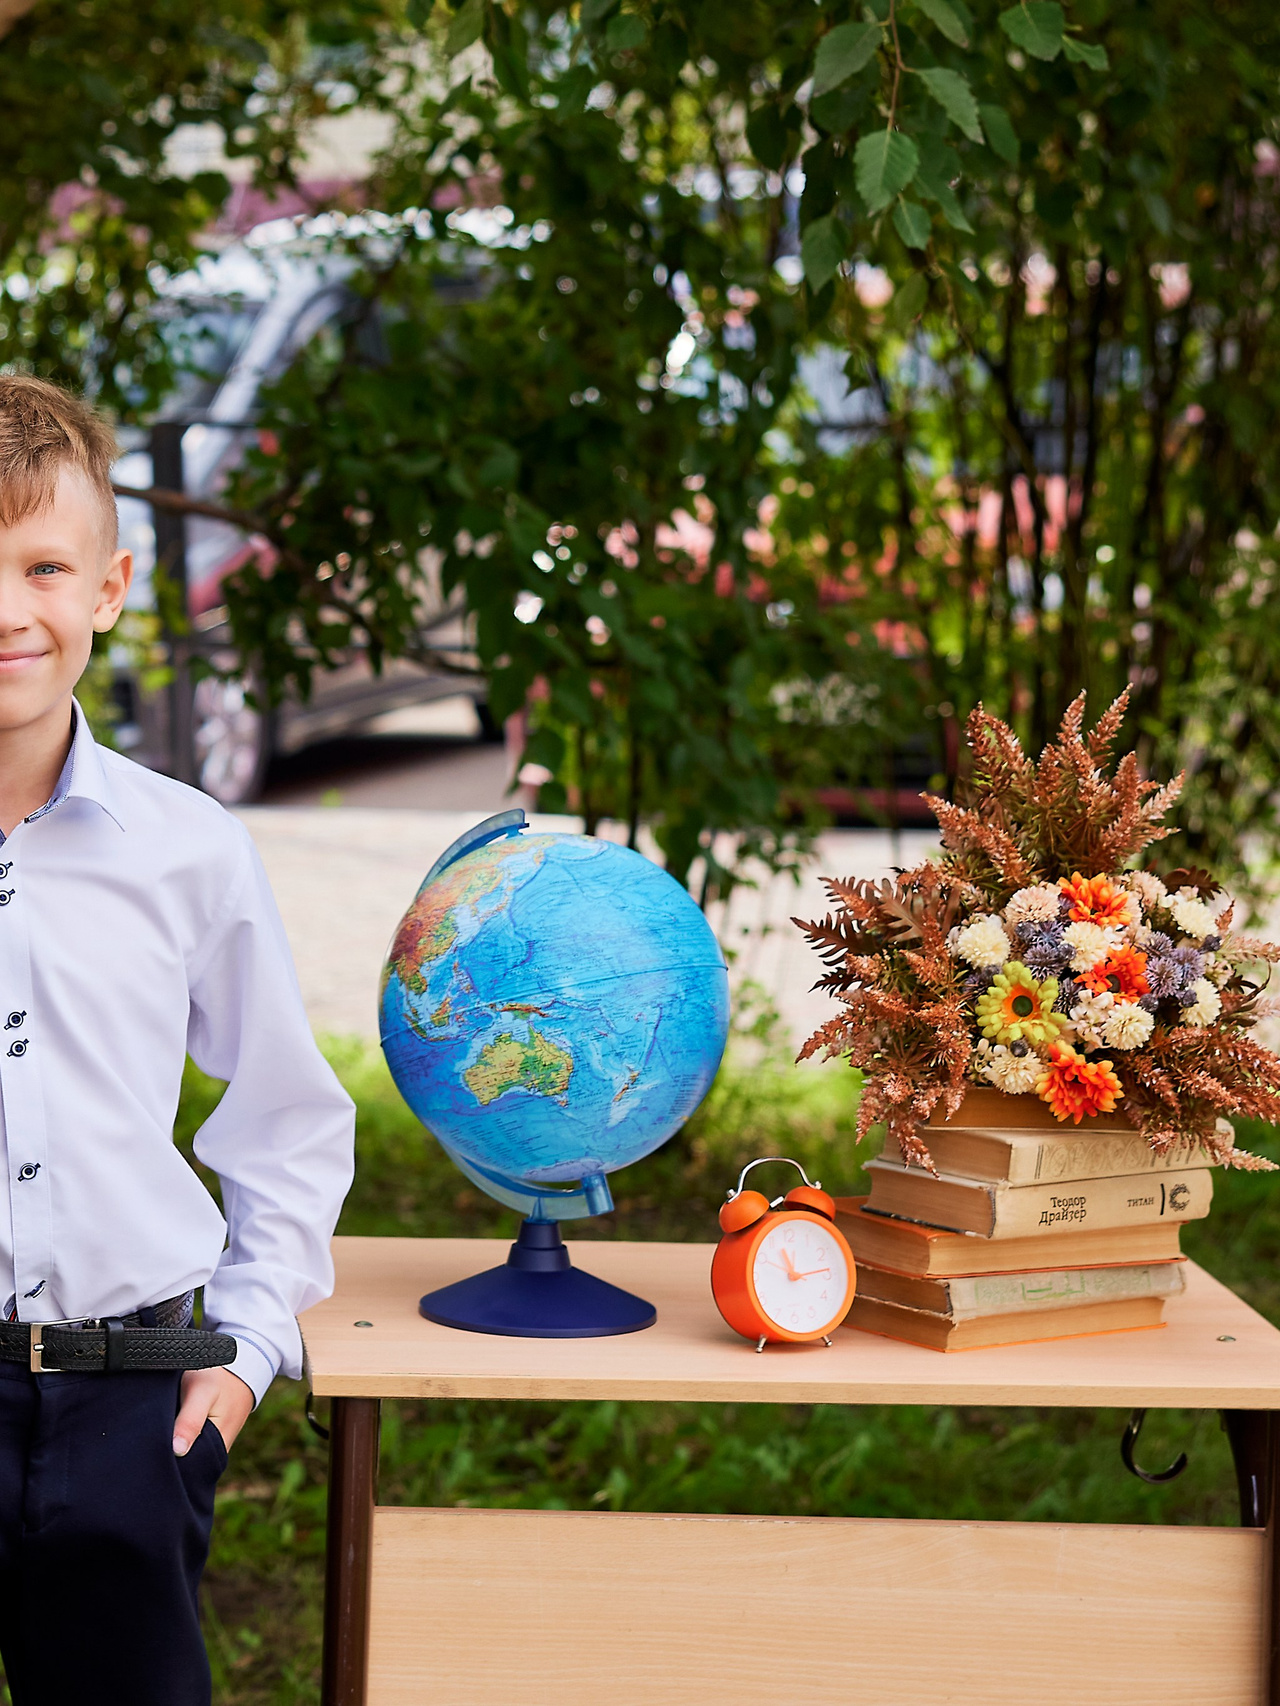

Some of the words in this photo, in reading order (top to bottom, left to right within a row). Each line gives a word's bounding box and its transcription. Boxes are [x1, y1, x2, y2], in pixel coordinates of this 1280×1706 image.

[1050, 1196, 1086, 1208] Теодор
[1127, 1197, 1155, 1207] ТИТАН
[1039, 1207, 1087, 1226] Драйзер
[782, 1228, 795, 1243] 12
[816, 1247, 825, 1261] 2
[819, 1289, 827, 1302] 4
[790, 1311, 799, 1324] 6
[807, 1305, 816, 1318] 5
